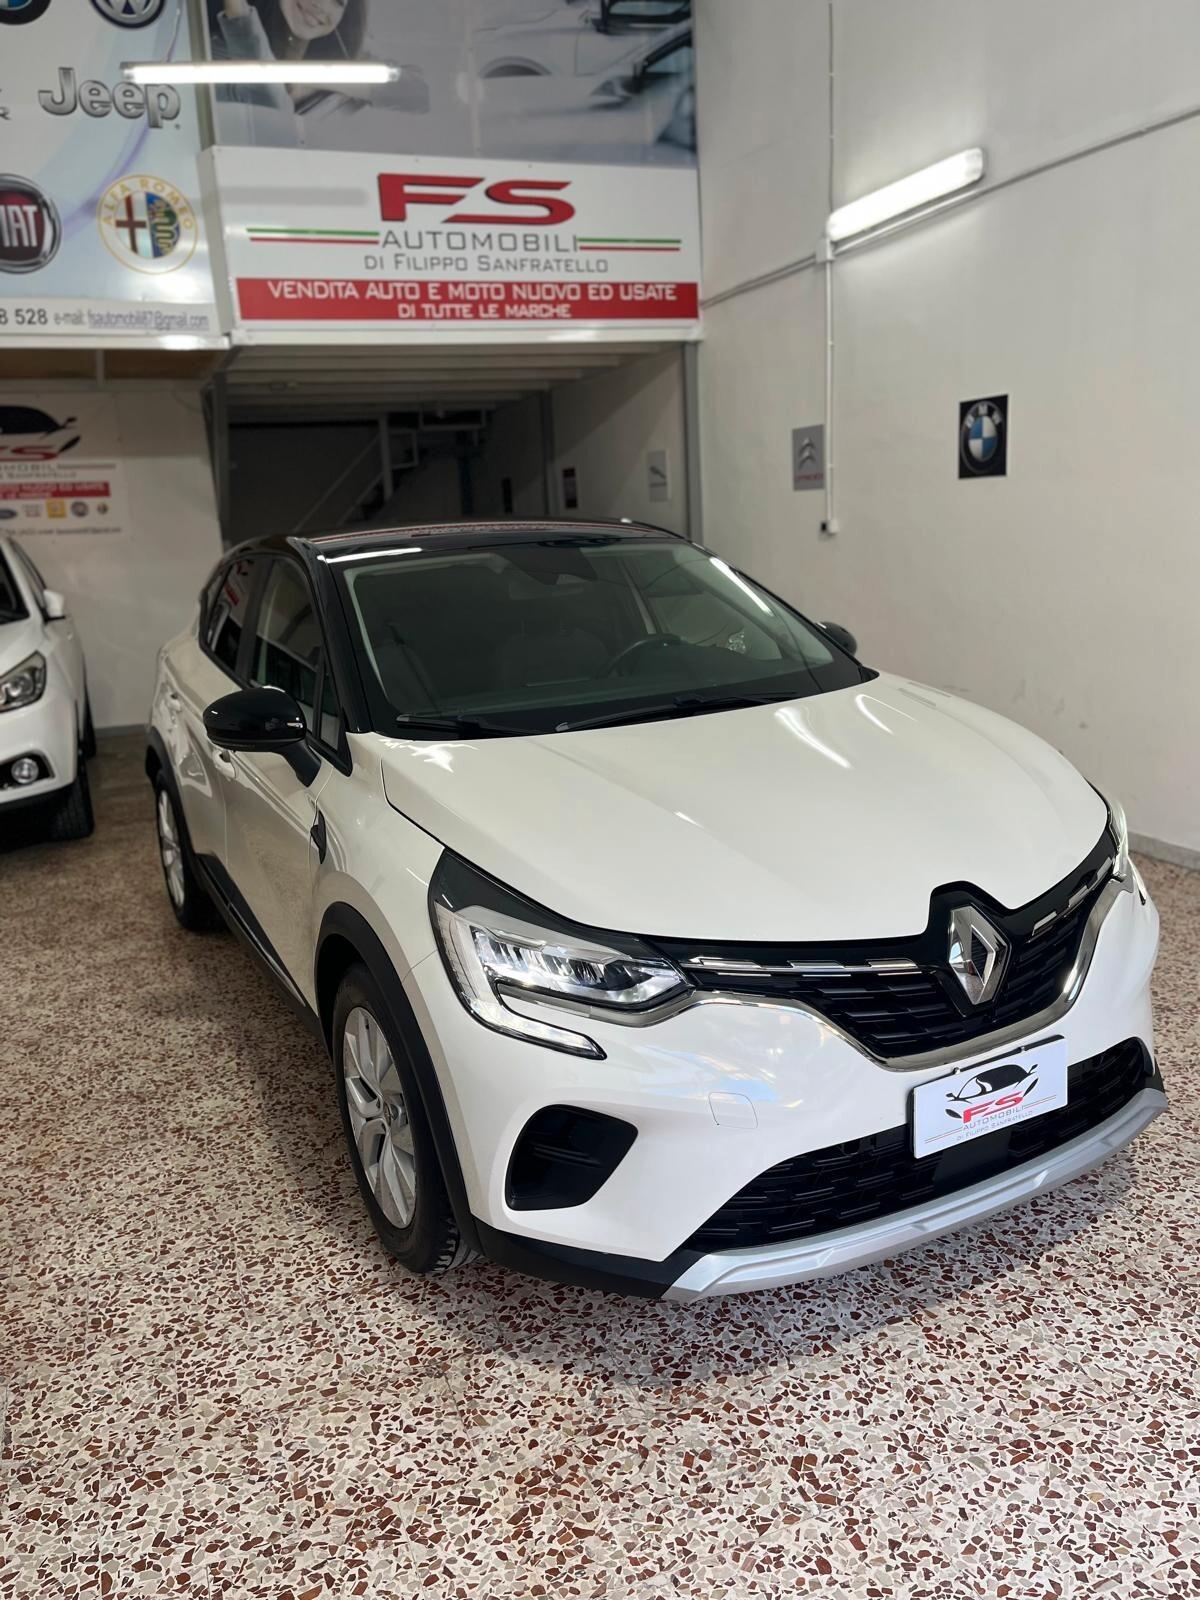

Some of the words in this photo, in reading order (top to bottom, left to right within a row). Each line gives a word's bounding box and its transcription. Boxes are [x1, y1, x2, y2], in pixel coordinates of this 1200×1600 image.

[38, 66, 181, 128] Jeep
[139, 178, 193, 230] ROMEO
[377, 173, 576, 226] FS
[0, 205, 38, 247] IAT
[382, 229, 578, 252] AUTOMOBILI
[364, 255, 385, 270] DI
[394, 253, 468, 272] FILIPPO
[478, 255, 609, 273] SANFRATELLO
[267, 280, 359, 299] VENDITA
[365, 283, 420, 300] AUTO
[428, 284, 440, 300] E
[449, 283, 505, 300] MOTO
[512, 284, 580, 300] NUOVO
[588, 284, 613, 300] ED
[620, 284, 677, 300] USATE
[14, 308, 48, 325] 528
[398, 304, 416, 318] DI
[421, 304, 473, 319] TUTTE
[479, 304, 499, 318] LE
[505, 304, 572, 318] MARCHE
[965, 403, 1003, 429] BMW
[963, 1090, 1024, 1124] FS
[963, 1106, 1025, 1131] AUTOMOBILI
